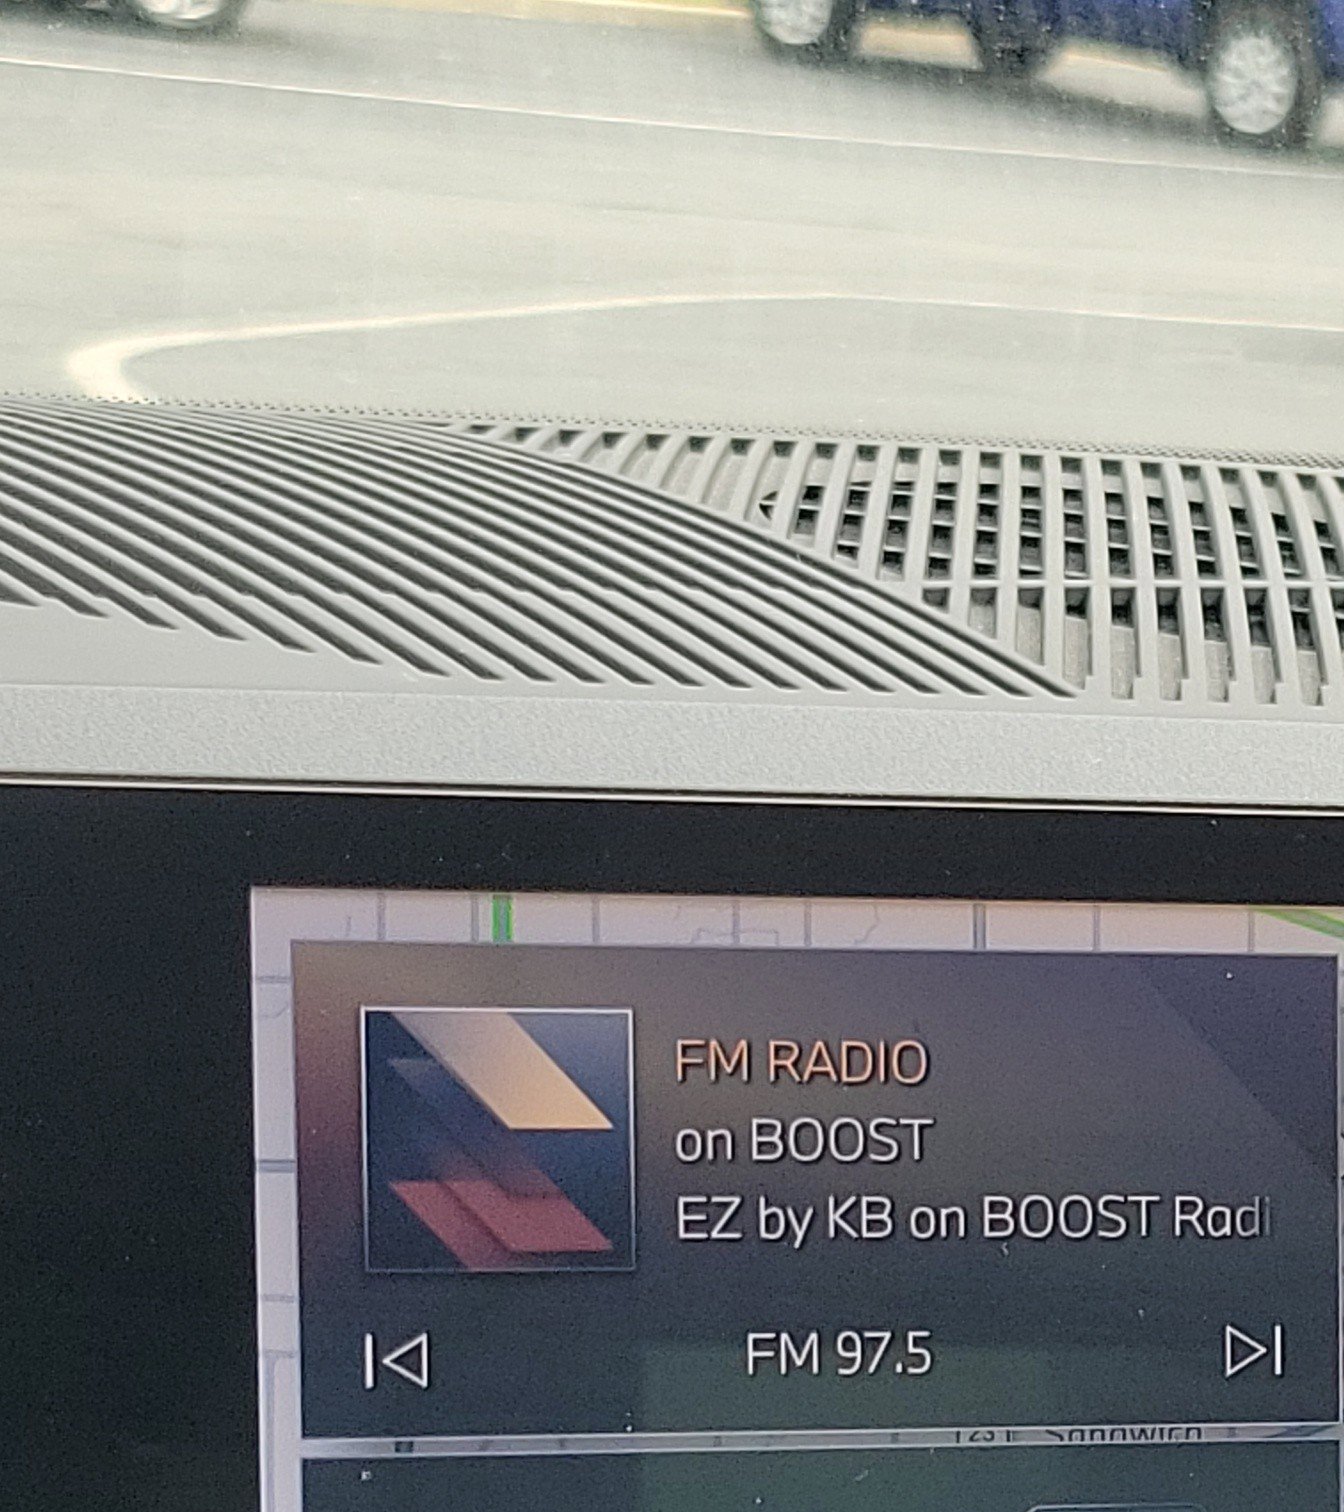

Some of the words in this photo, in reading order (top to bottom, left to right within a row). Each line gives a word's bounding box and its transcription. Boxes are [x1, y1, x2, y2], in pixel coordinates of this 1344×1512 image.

[676, 1040, 749, 1083] FM
[769, 1040, 928, 1085] RADIO
[675, 1126, 733, 1162] on
[751, 1118, 935, 1162] BOOST
[677, 1197, 742, 1240] EZ
[759, 1197, 813, 1248] by
[829, 1197, 894, 1240] KB
[910, 1205, 965, 1239] on
[983, 1196, 1160, 1239] BOOST
[747, 1333, 819, 1376] FM
[837, 1331, 932, 1376] 97.5
